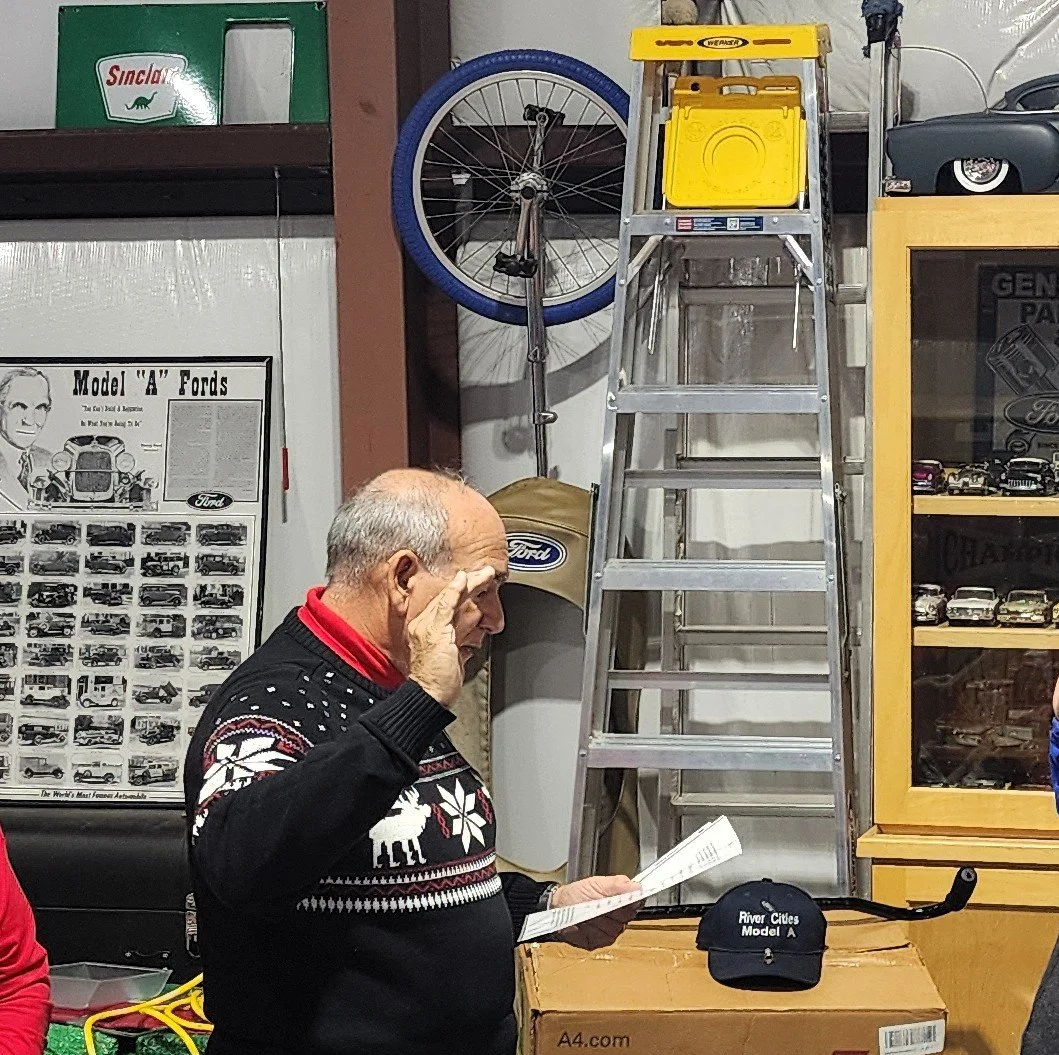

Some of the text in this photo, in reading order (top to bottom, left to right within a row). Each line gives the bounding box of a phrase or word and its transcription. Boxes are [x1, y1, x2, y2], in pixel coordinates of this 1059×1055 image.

[73, 369, 228, 397] Model "A" Fords
[194, 492, 226, 508] Ford
[508, 539, 552, 561] Ford
[738, 910, 800, 926] River Cities
[741, 925, 797, 938] Model A
[557, 1031, 630, 1048] A4.com
